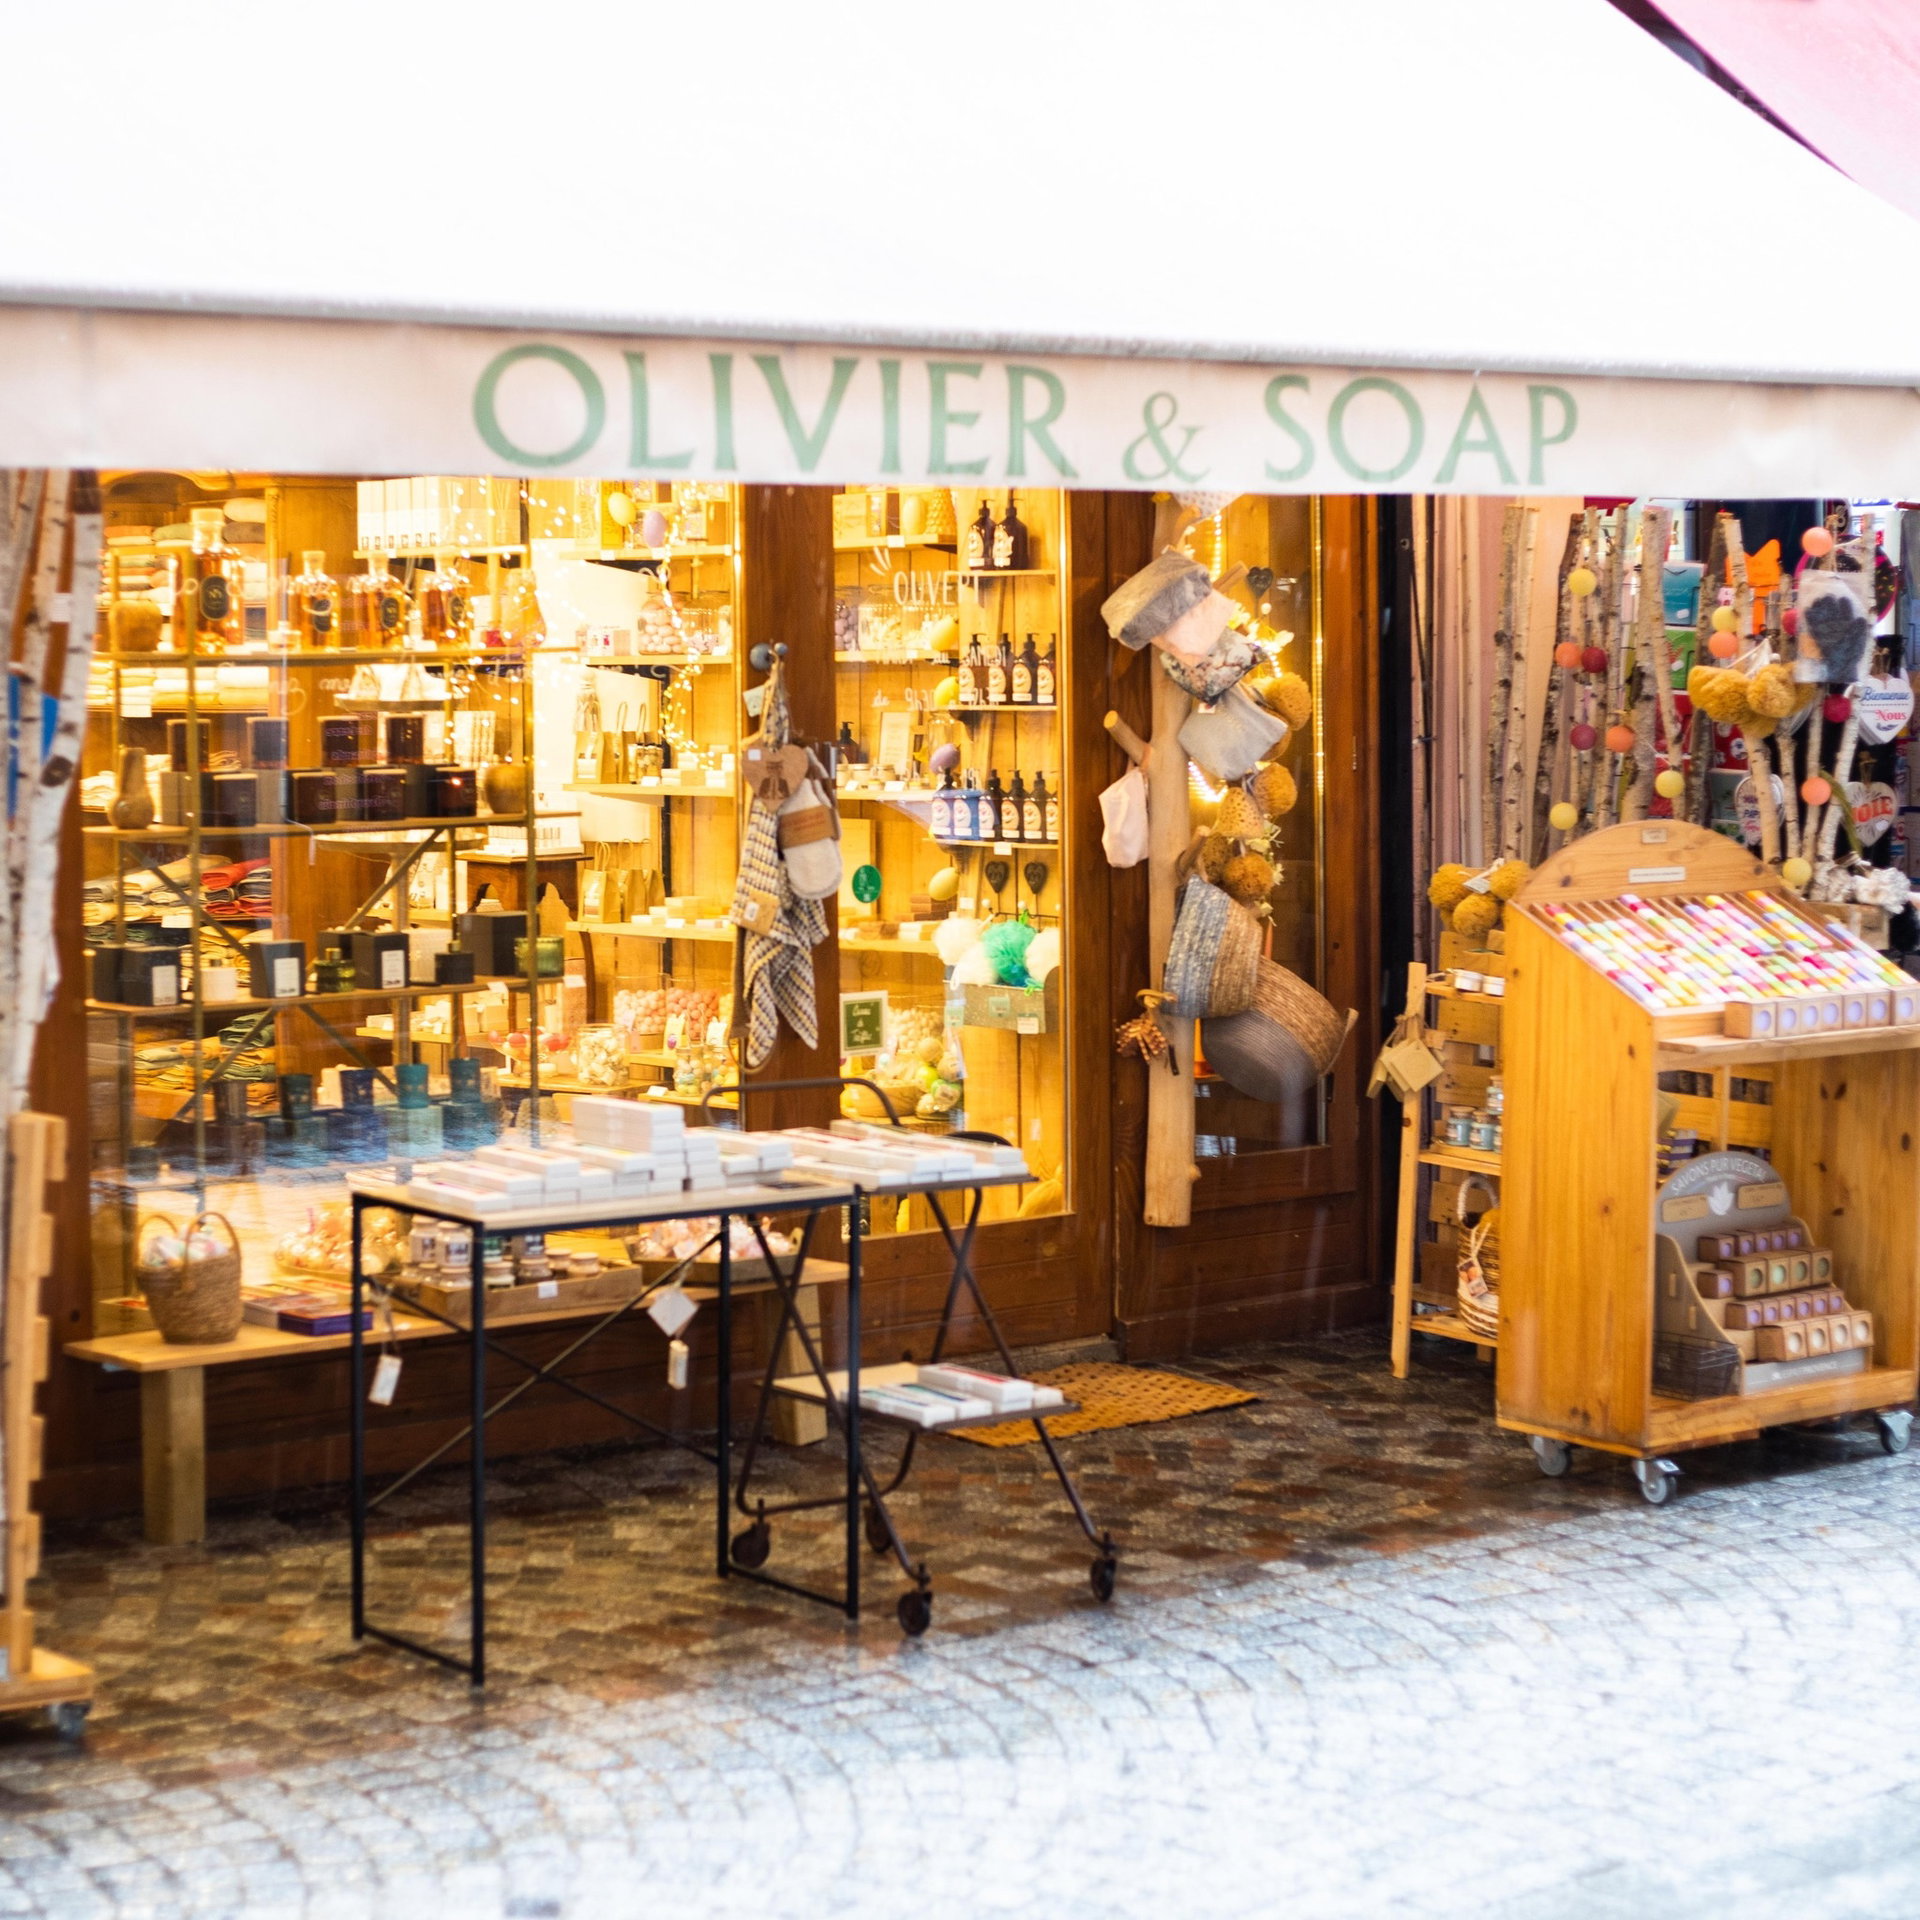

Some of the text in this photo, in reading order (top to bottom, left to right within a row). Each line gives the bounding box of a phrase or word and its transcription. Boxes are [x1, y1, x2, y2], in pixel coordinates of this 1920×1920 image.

[472, 342, 1579, 486] OLIVIER & SOAP
[893, 570, 981, 606] OUVERT
[1875, 709, 1906, 721] Nous
[1671, 1162, 1710, 1195] SAVONS
